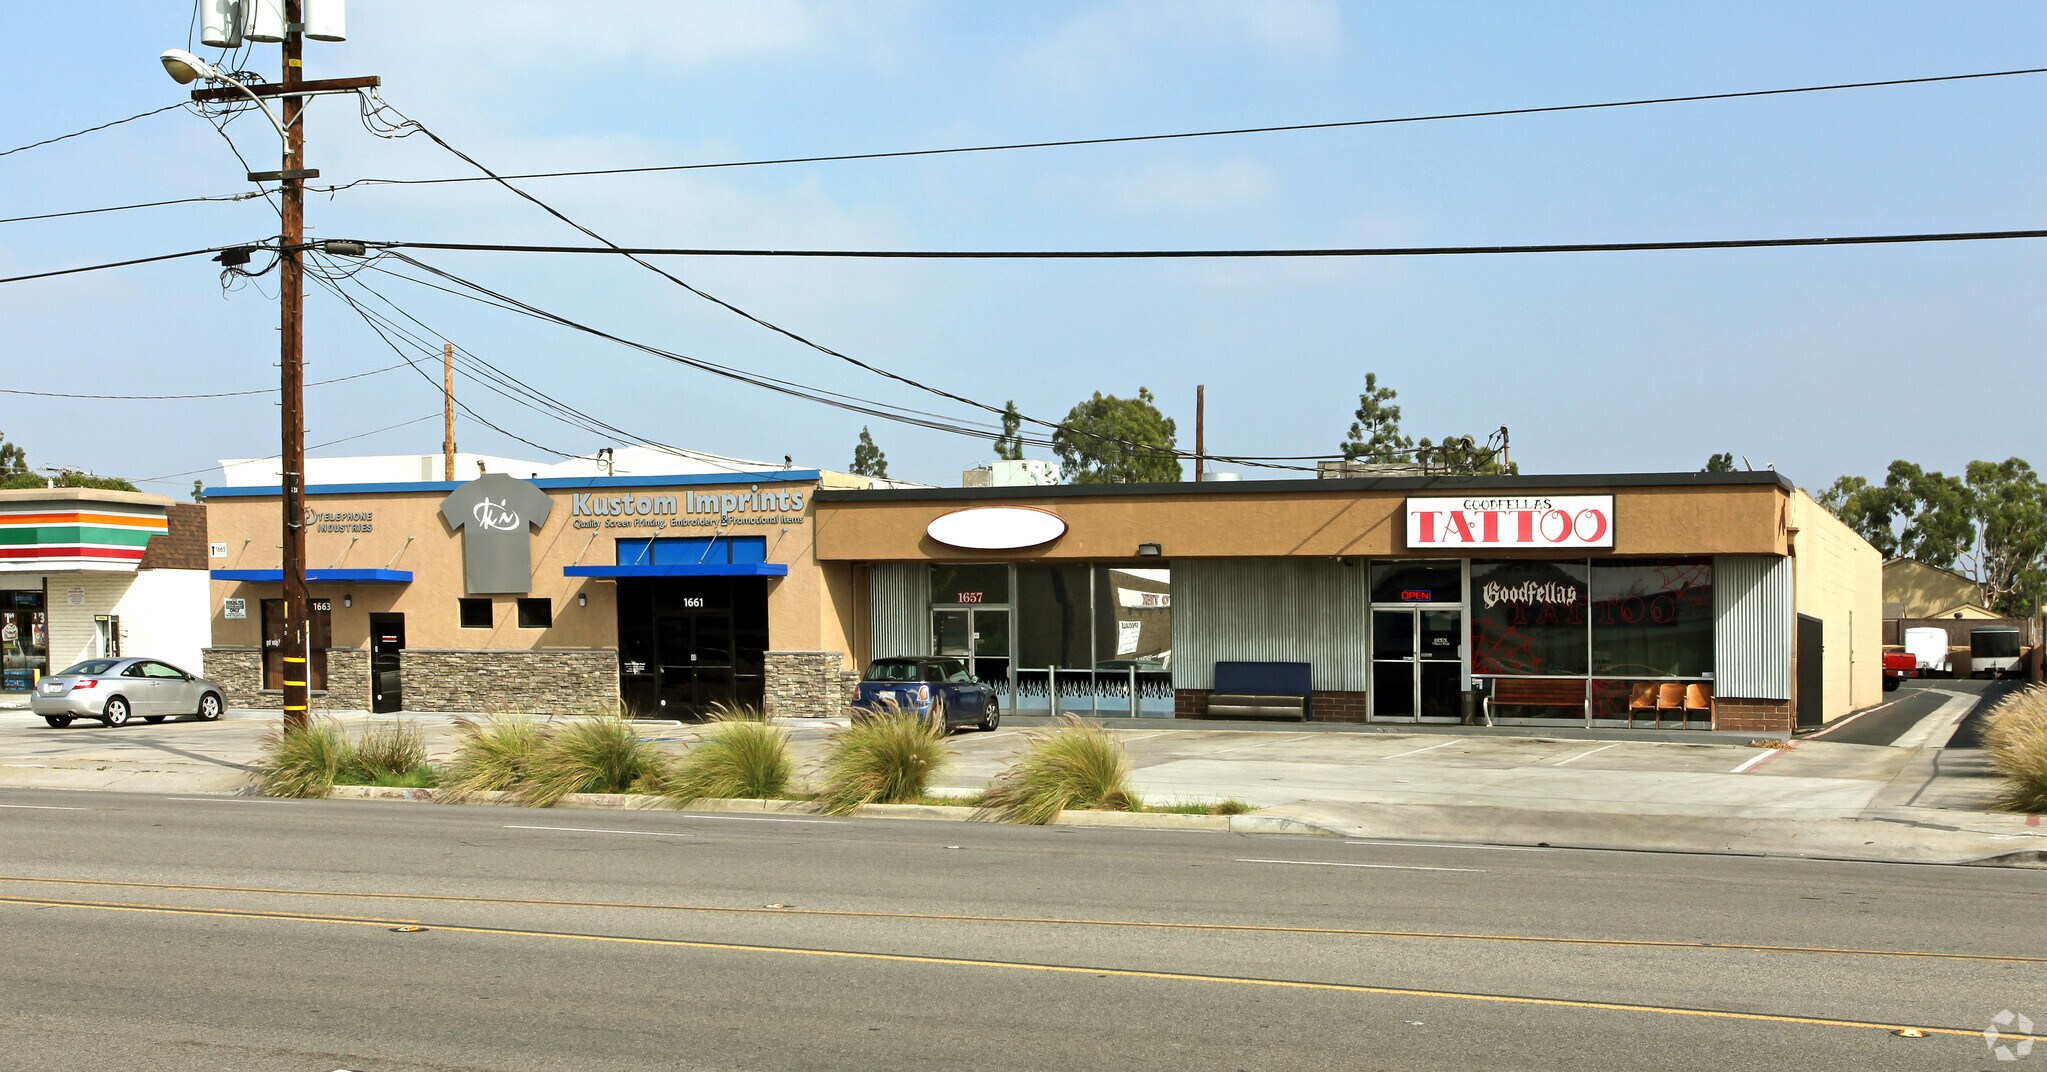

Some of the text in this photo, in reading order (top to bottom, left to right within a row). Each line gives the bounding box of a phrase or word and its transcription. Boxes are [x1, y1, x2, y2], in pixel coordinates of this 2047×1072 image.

[572, 484, 804, 525] Kustom Imprints
[1463, 499, 1552, 510] GOODFELLAS
[317, 512, 373, 522] TELEPHONE
[573, 514, 804, 530] Quality Screen Printing, Embroidery & Promotional Items
[317, 523, 373, 533] INDUSTRIES
[1411, 508, 1607, 543] TATTOO
[958, 592, 983, 603] 1657
[1401, 591, 1430, 600] OPEN
[1482, 580, 1577, 609] Goodfellas
[313, 602, 331, 611] 1663
[683, 597, 704, 607] 1661
[1508, 595, 1676, 624] TATTOO
